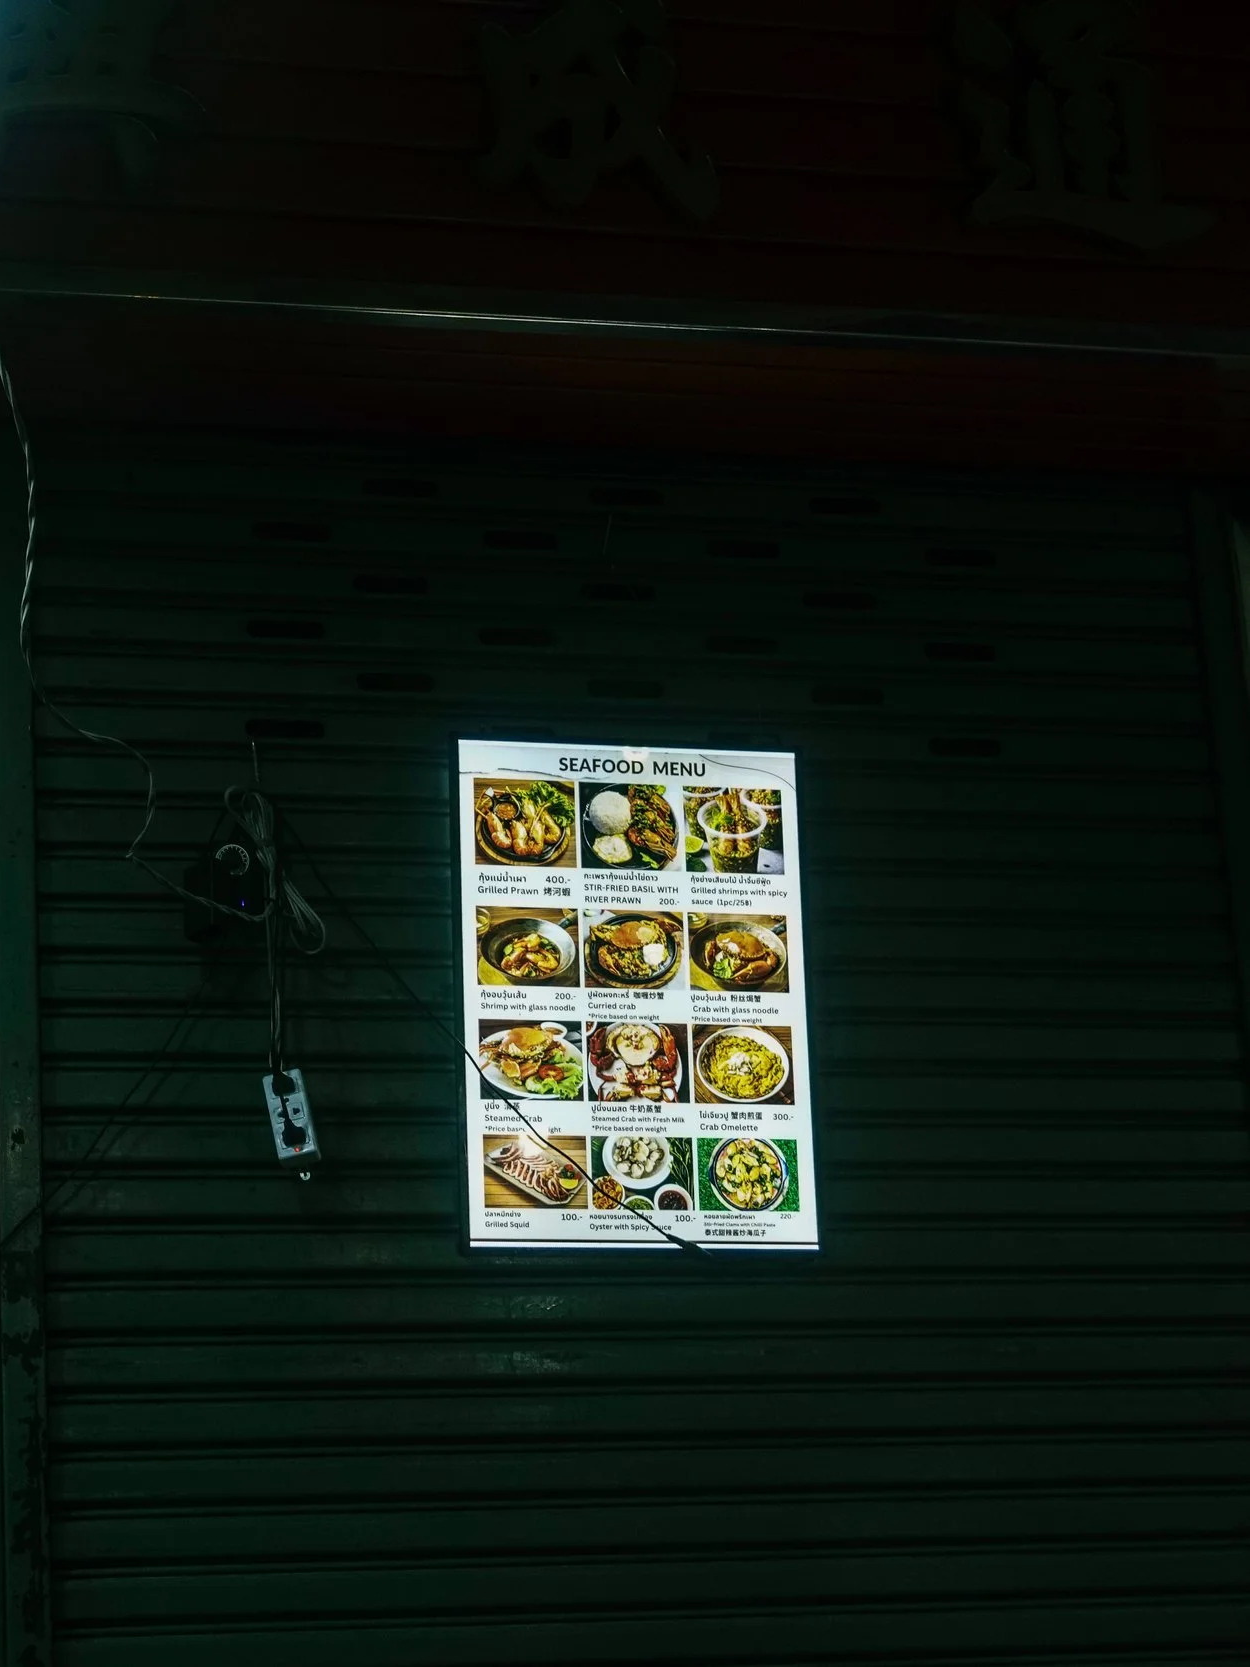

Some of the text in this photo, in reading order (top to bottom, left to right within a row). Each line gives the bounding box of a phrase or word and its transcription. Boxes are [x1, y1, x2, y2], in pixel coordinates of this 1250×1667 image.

[559, 757, 706, 777] SEAFOOD MENU
[545, 875, 570, 884] 400.-
[477, 885, 508, 894] Grilled
[511, 887, 539, 895] Prawn
[584, 884, 629, 892] STIR-FRIED
[632, 885, 655, 893] BASIL
[718, 888, 748, 896] shrimps
[768, 890, 788, 898] spicy
[611, 896, 641, 904] PRAWN
[481, 1002, 508, 1011] Shrimp
[529, 1004, 547, 1012] glass
[588, 1002, 617, 1010] Curried
[693, 1005, 711, 1013] Crab
[731, 1007, 750, 1015] glass
[484, 1114, 521, 1122] Steamed
[700, 1123, 758, 1132] Crab Omelette
[561, 1213, 582, 1221] 100.-
